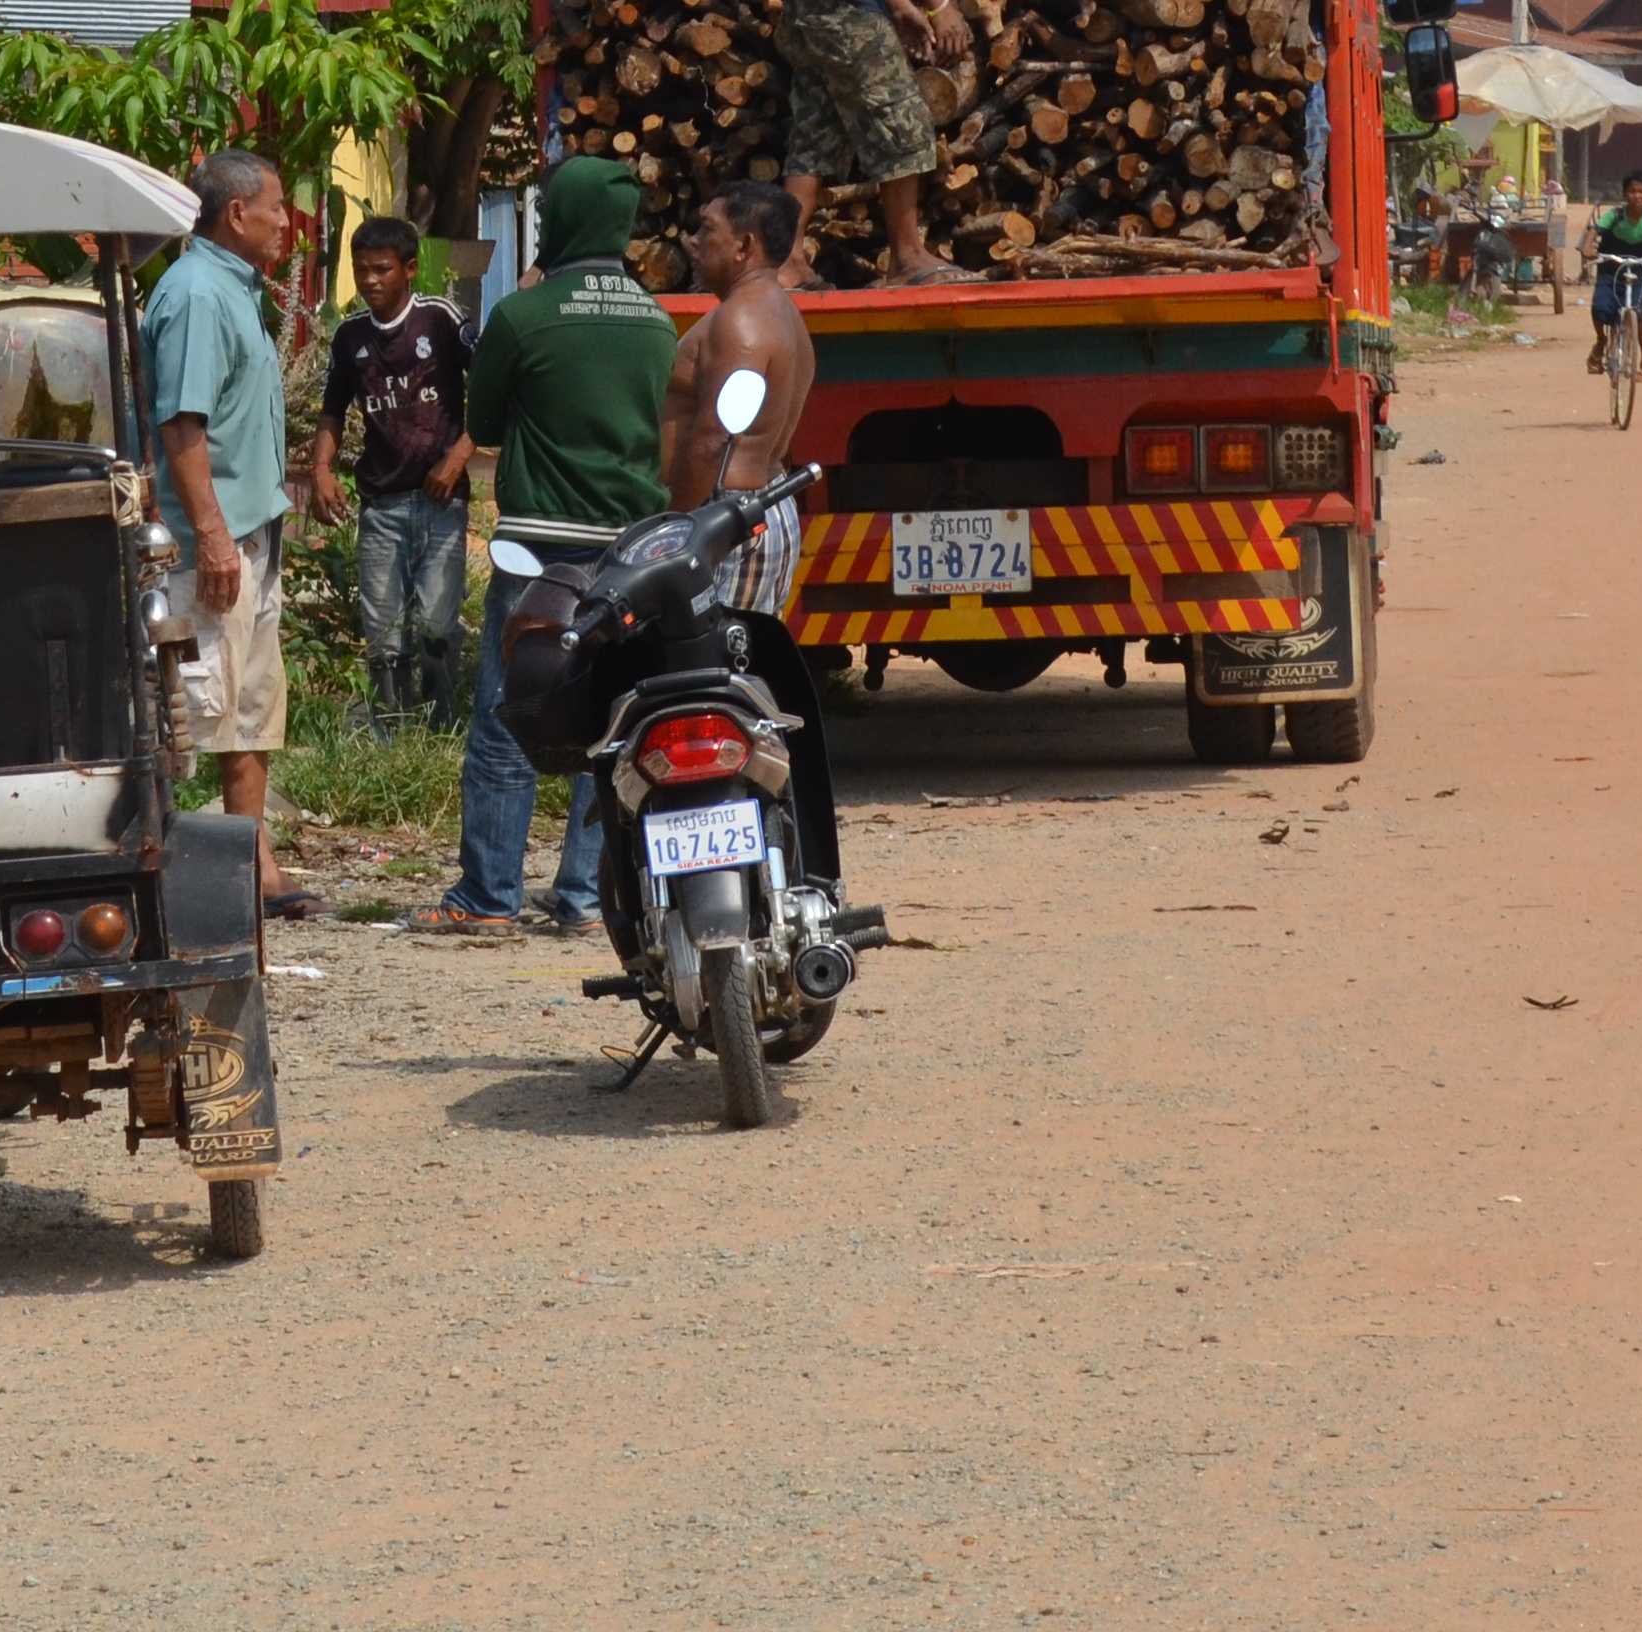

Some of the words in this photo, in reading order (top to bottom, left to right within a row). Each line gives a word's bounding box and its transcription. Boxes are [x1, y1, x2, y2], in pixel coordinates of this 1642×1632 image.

[972, 582, 1013, 592] PENH
[1220, 668, 1260, 680] HIGH
[1266, 664, 1338, 679] QUALITY
[1242, 676, 1318, 688] MUDGUARD
[677, 860, 705, 870] SIEM
[707, 855, 739, 866] REAP
[190, 1131, 275, 1152] UALITY
